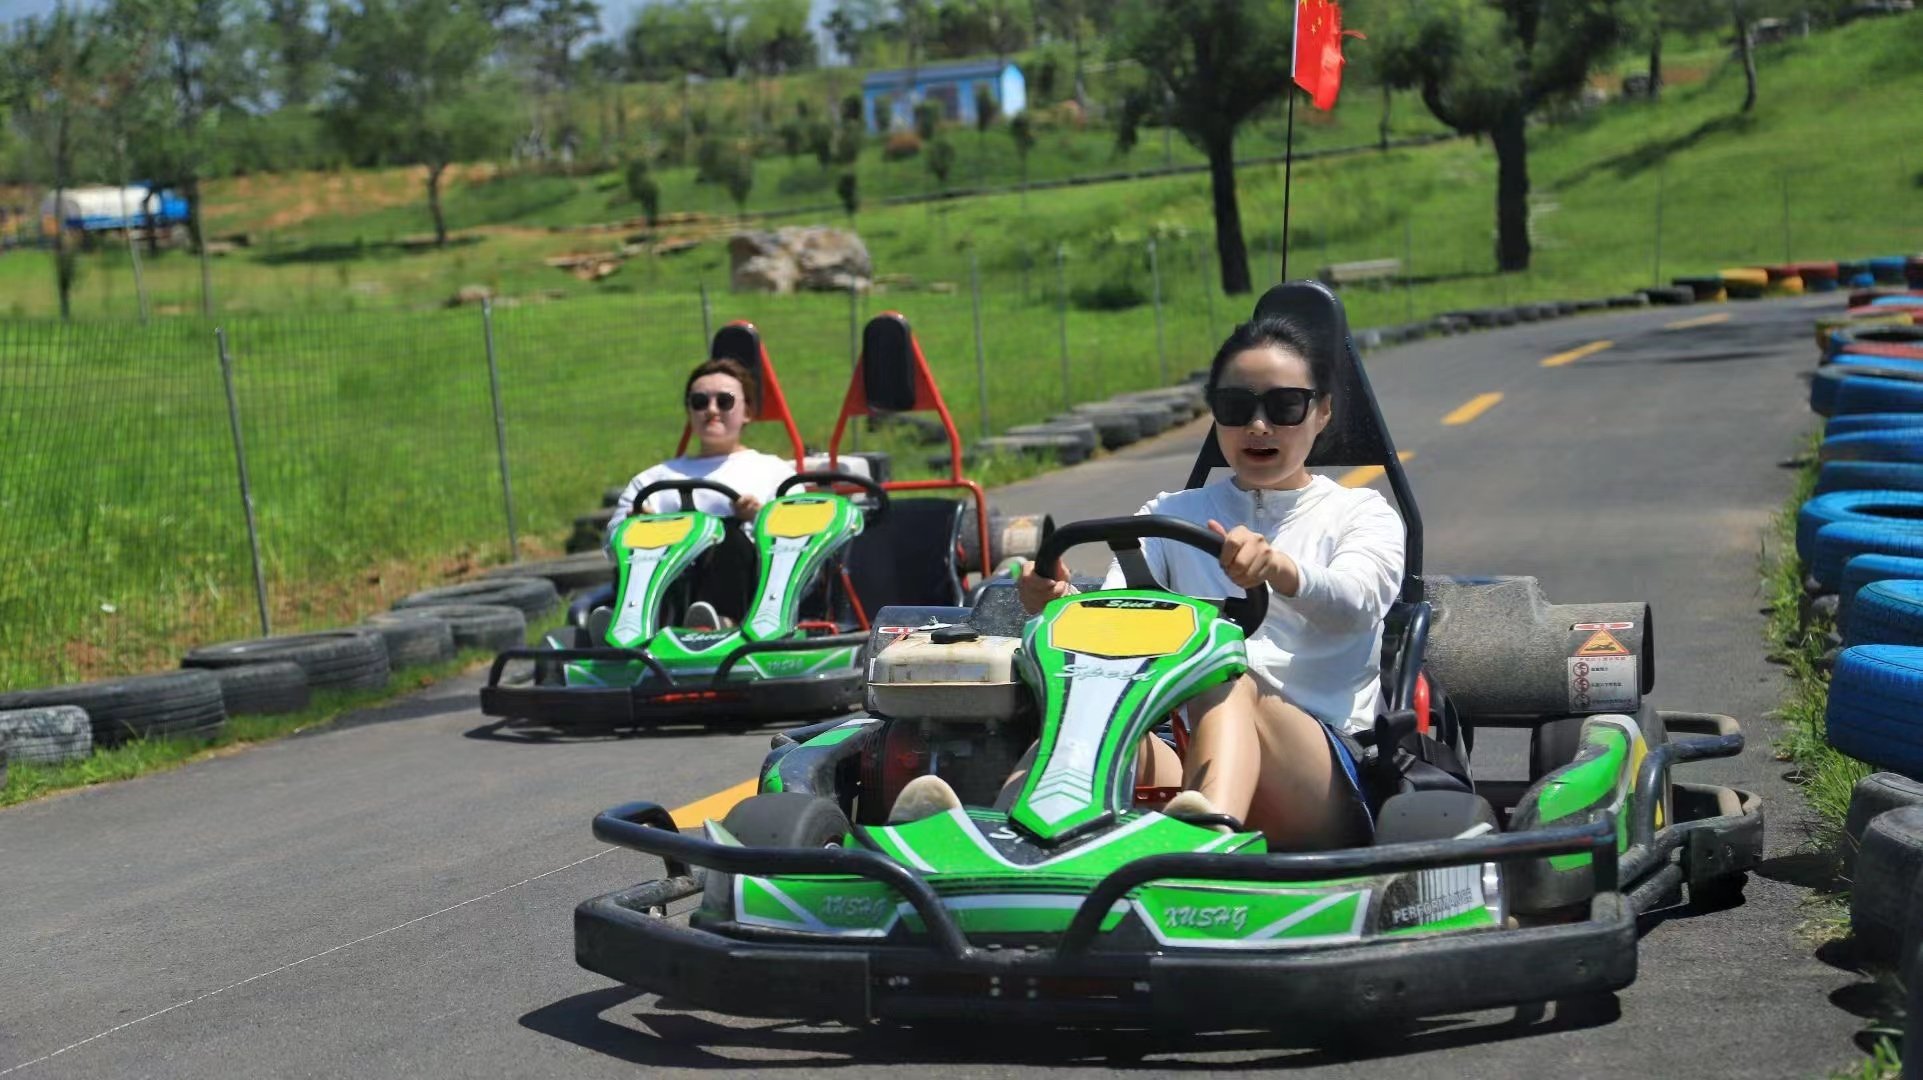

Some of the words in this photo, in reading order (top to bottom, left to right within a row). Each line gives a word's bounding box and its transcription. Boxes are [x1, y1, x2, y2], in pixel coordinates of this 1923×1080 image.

[1106, 600, 1156, 609] Speed
[1053, 664, 1157, 682] Speed
[1164, 905, 1248, 932] XUSHG
